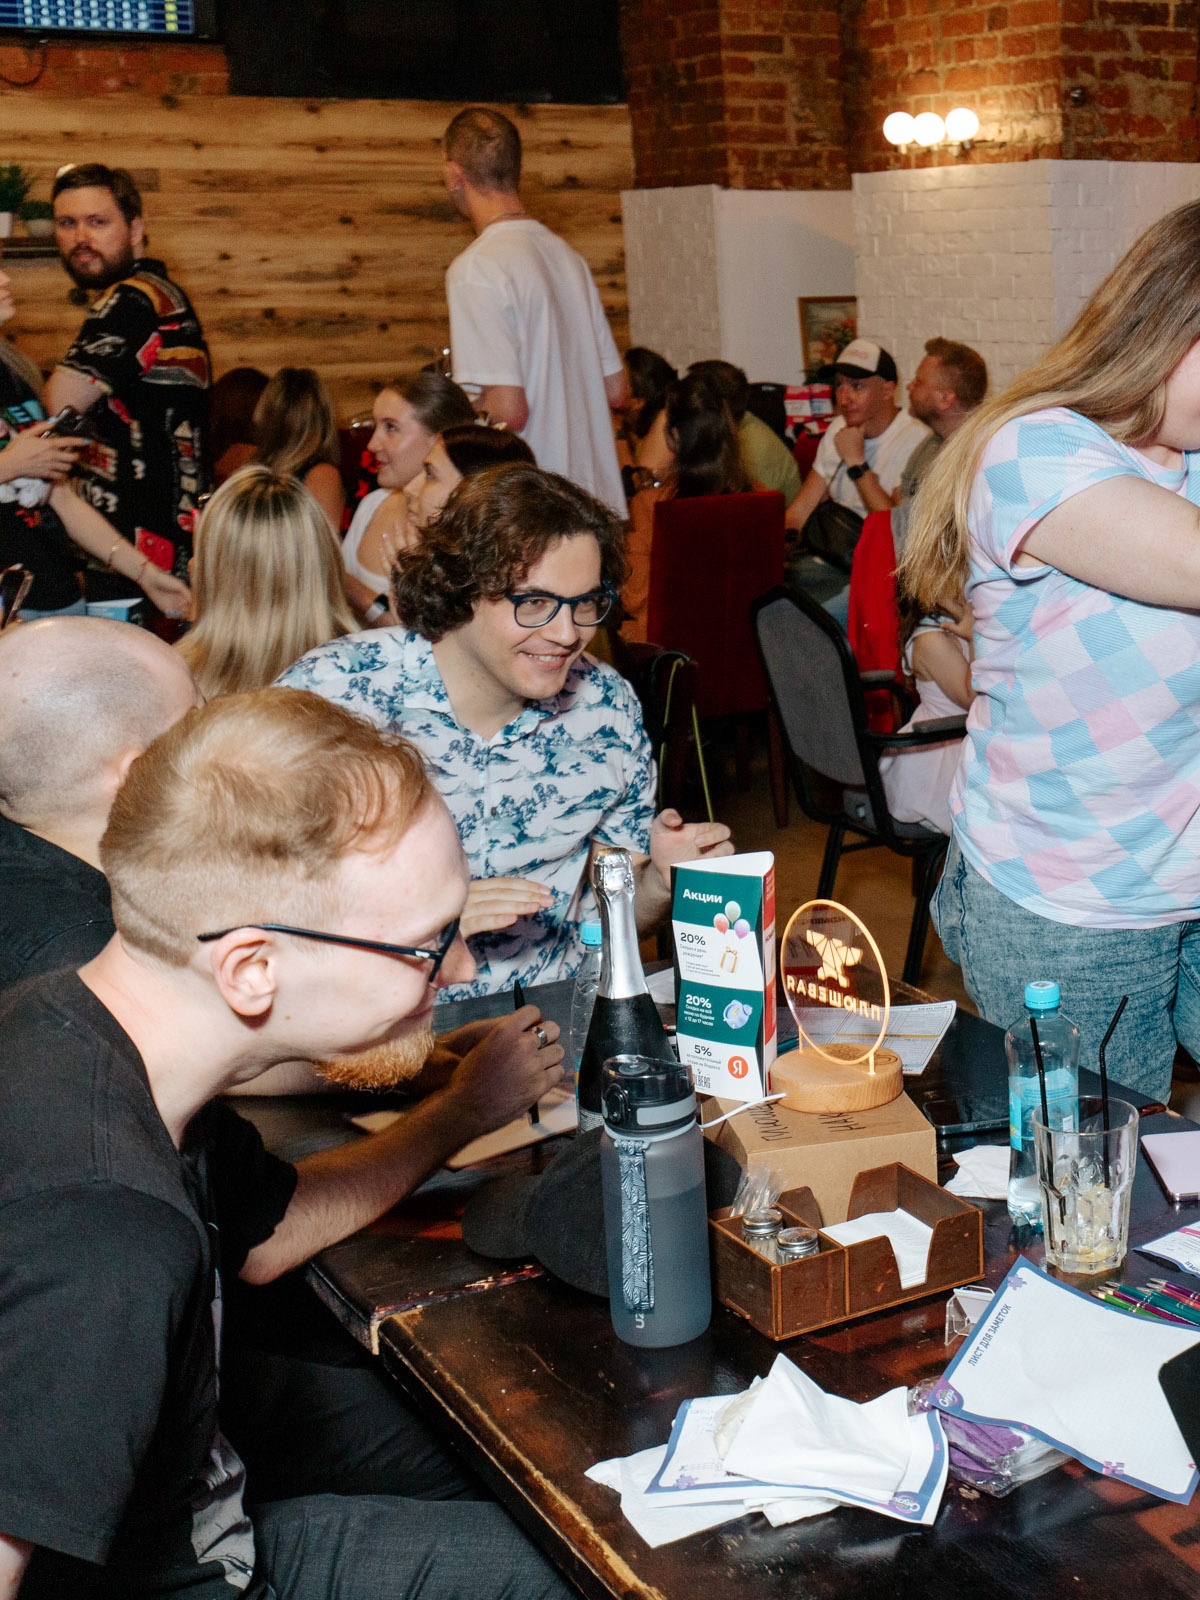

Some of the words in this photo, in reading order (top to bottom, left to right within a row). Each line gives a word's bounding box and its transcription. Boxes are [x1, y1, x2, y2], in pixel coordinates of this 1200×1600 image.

[682, 889, 722, 903] Акции
[680, 932, 706, 946] 20%
[685, 994, 711, 1008] 20%
[694, 1044, 712, 1056] 5%
[968, 1347, 985, 1366] ЛИСТ
[980, 1333, 992, 1349] ДЛЯ
[988, 1303, 1012, 1334] ЗАМЕТОК
